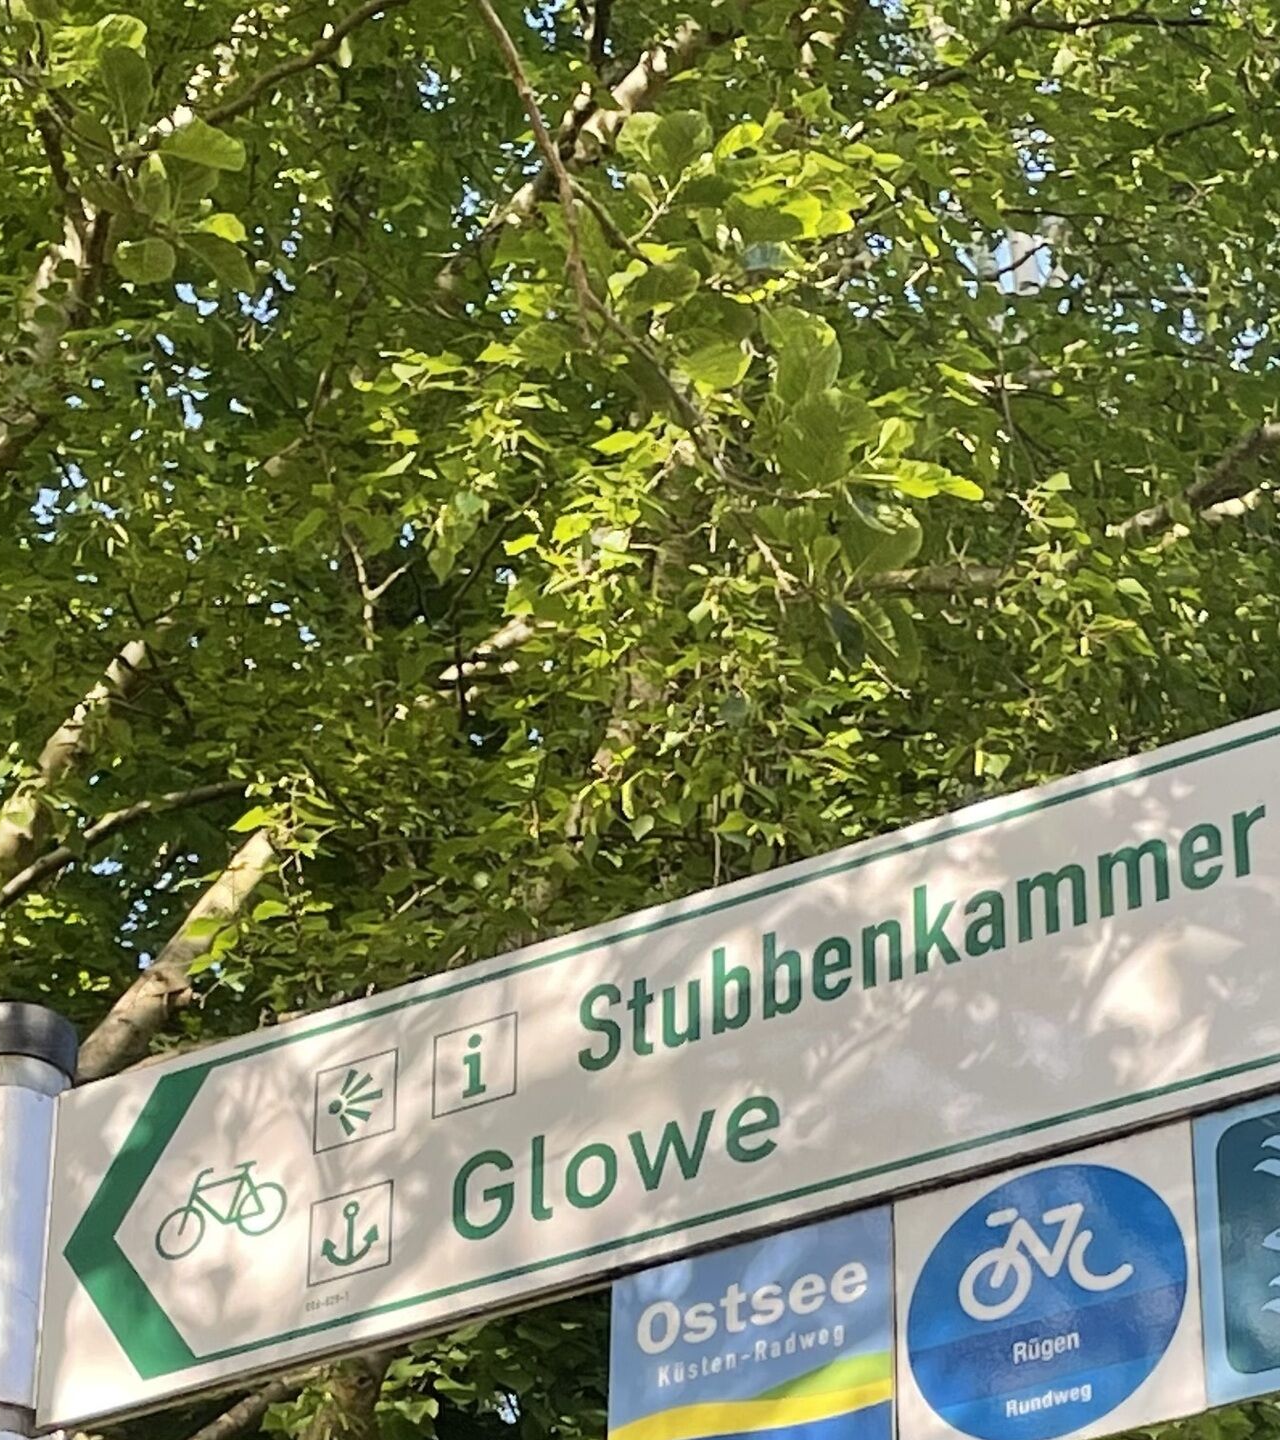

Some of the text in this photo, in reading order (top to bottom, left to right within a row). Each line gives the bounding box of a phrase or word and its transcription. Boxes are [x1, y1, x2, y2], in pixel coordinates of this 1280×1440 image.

[578, 802, 1267, 1073] Stubbenkammer
[450, 1095, 782, 1241] Glowe
[636, 1261, 869, 1355] Ostsee
[657, 1324, 845, 1388] Küsten-Radweg
[1013, 1331, 1080, 1365] Rügen
[1005, 1383, 1093, 1418] Rundweg
